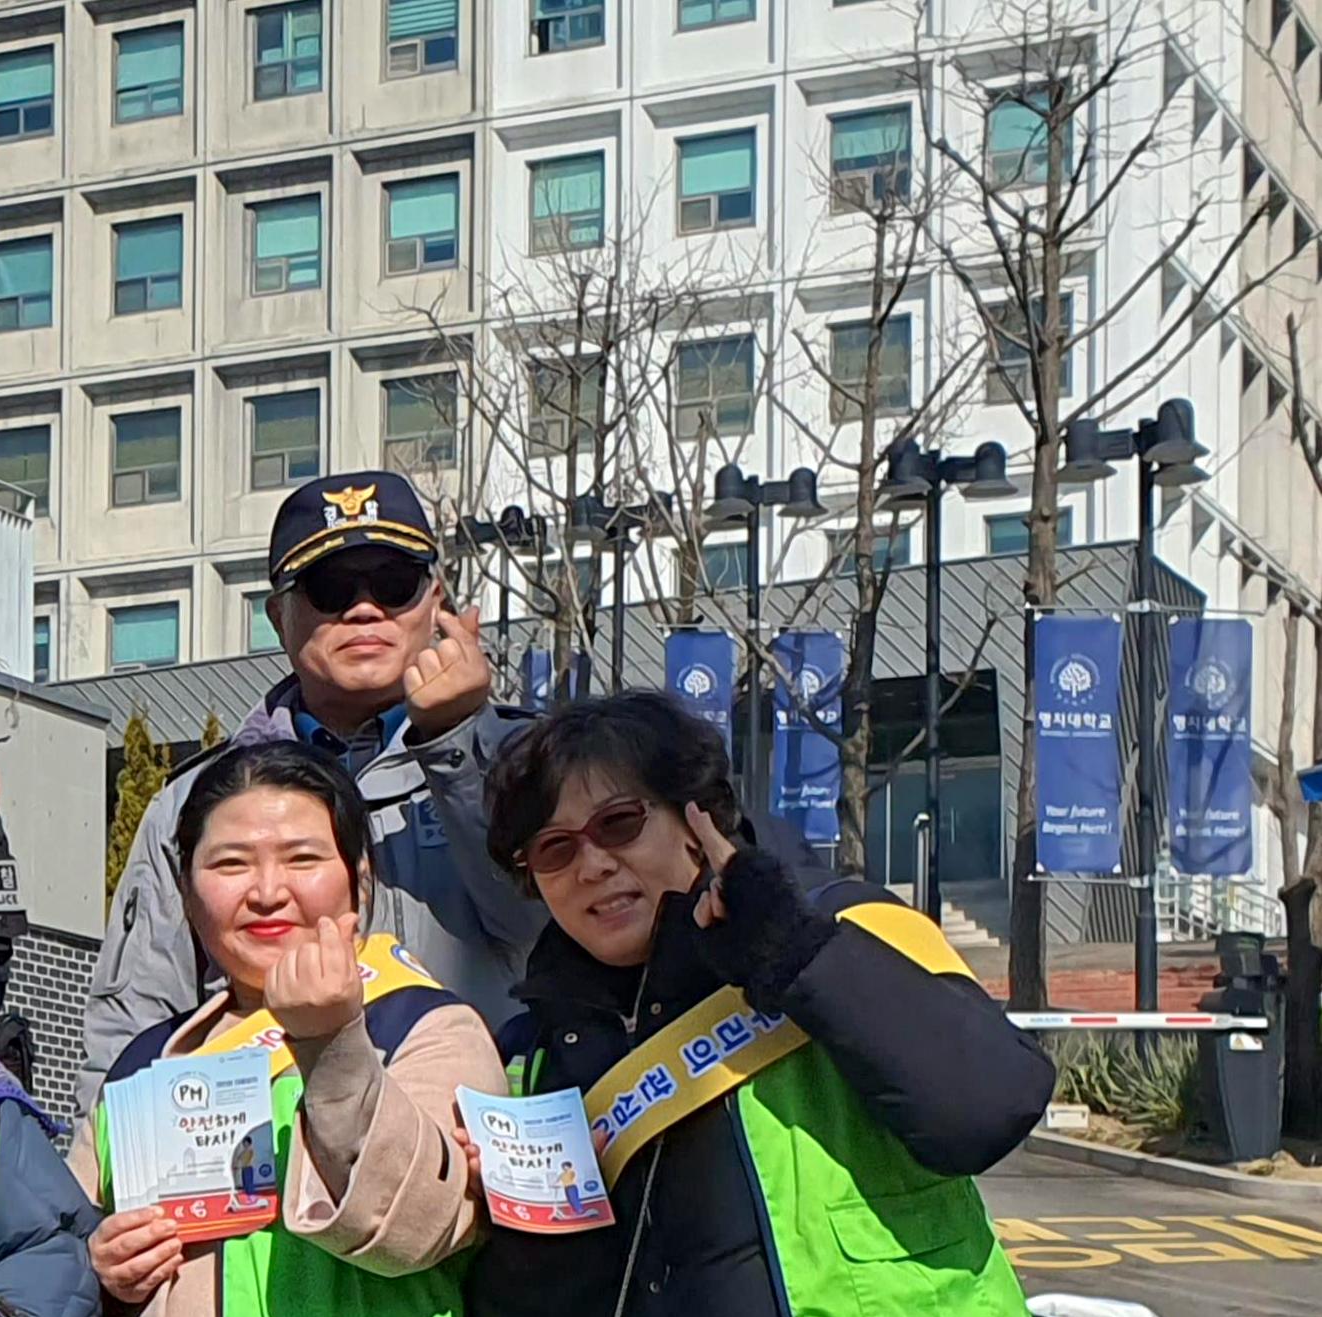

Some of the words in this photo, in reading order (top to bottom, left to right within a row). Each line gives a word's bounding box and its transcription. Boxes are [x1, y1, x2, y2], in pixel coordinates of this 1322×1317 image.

[1039, 711, 1112, 730] 명지대학교
[180, 1084, 202, 1102] PM
[179, 1112, 246, 1132] 안전하게
